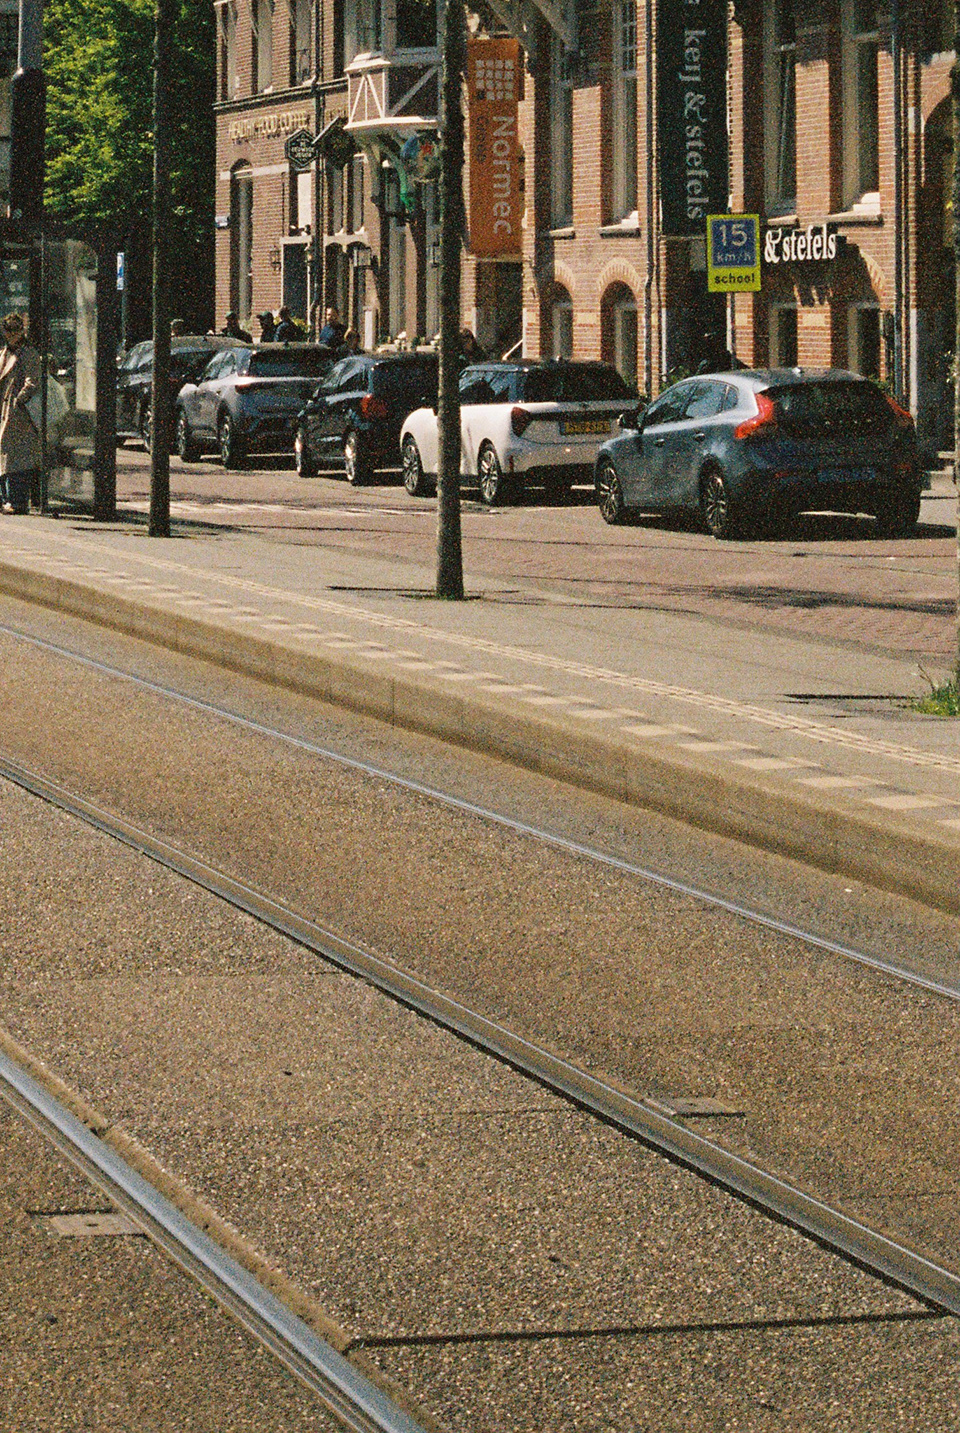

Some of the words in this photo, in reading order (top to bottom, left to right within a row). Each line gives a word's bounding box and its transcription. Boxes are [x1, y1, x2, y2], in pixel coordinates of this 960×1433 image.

[683, 91, 708, 123] &
[492, 116, 515, 235] Normec
[685, 125, 709, 219] stefels
[719, 223, 748, 247] 15
[764, 228, 782, 263] &
[782, 223, 836, 262] stefels
[714, 273, 755, 284] school
